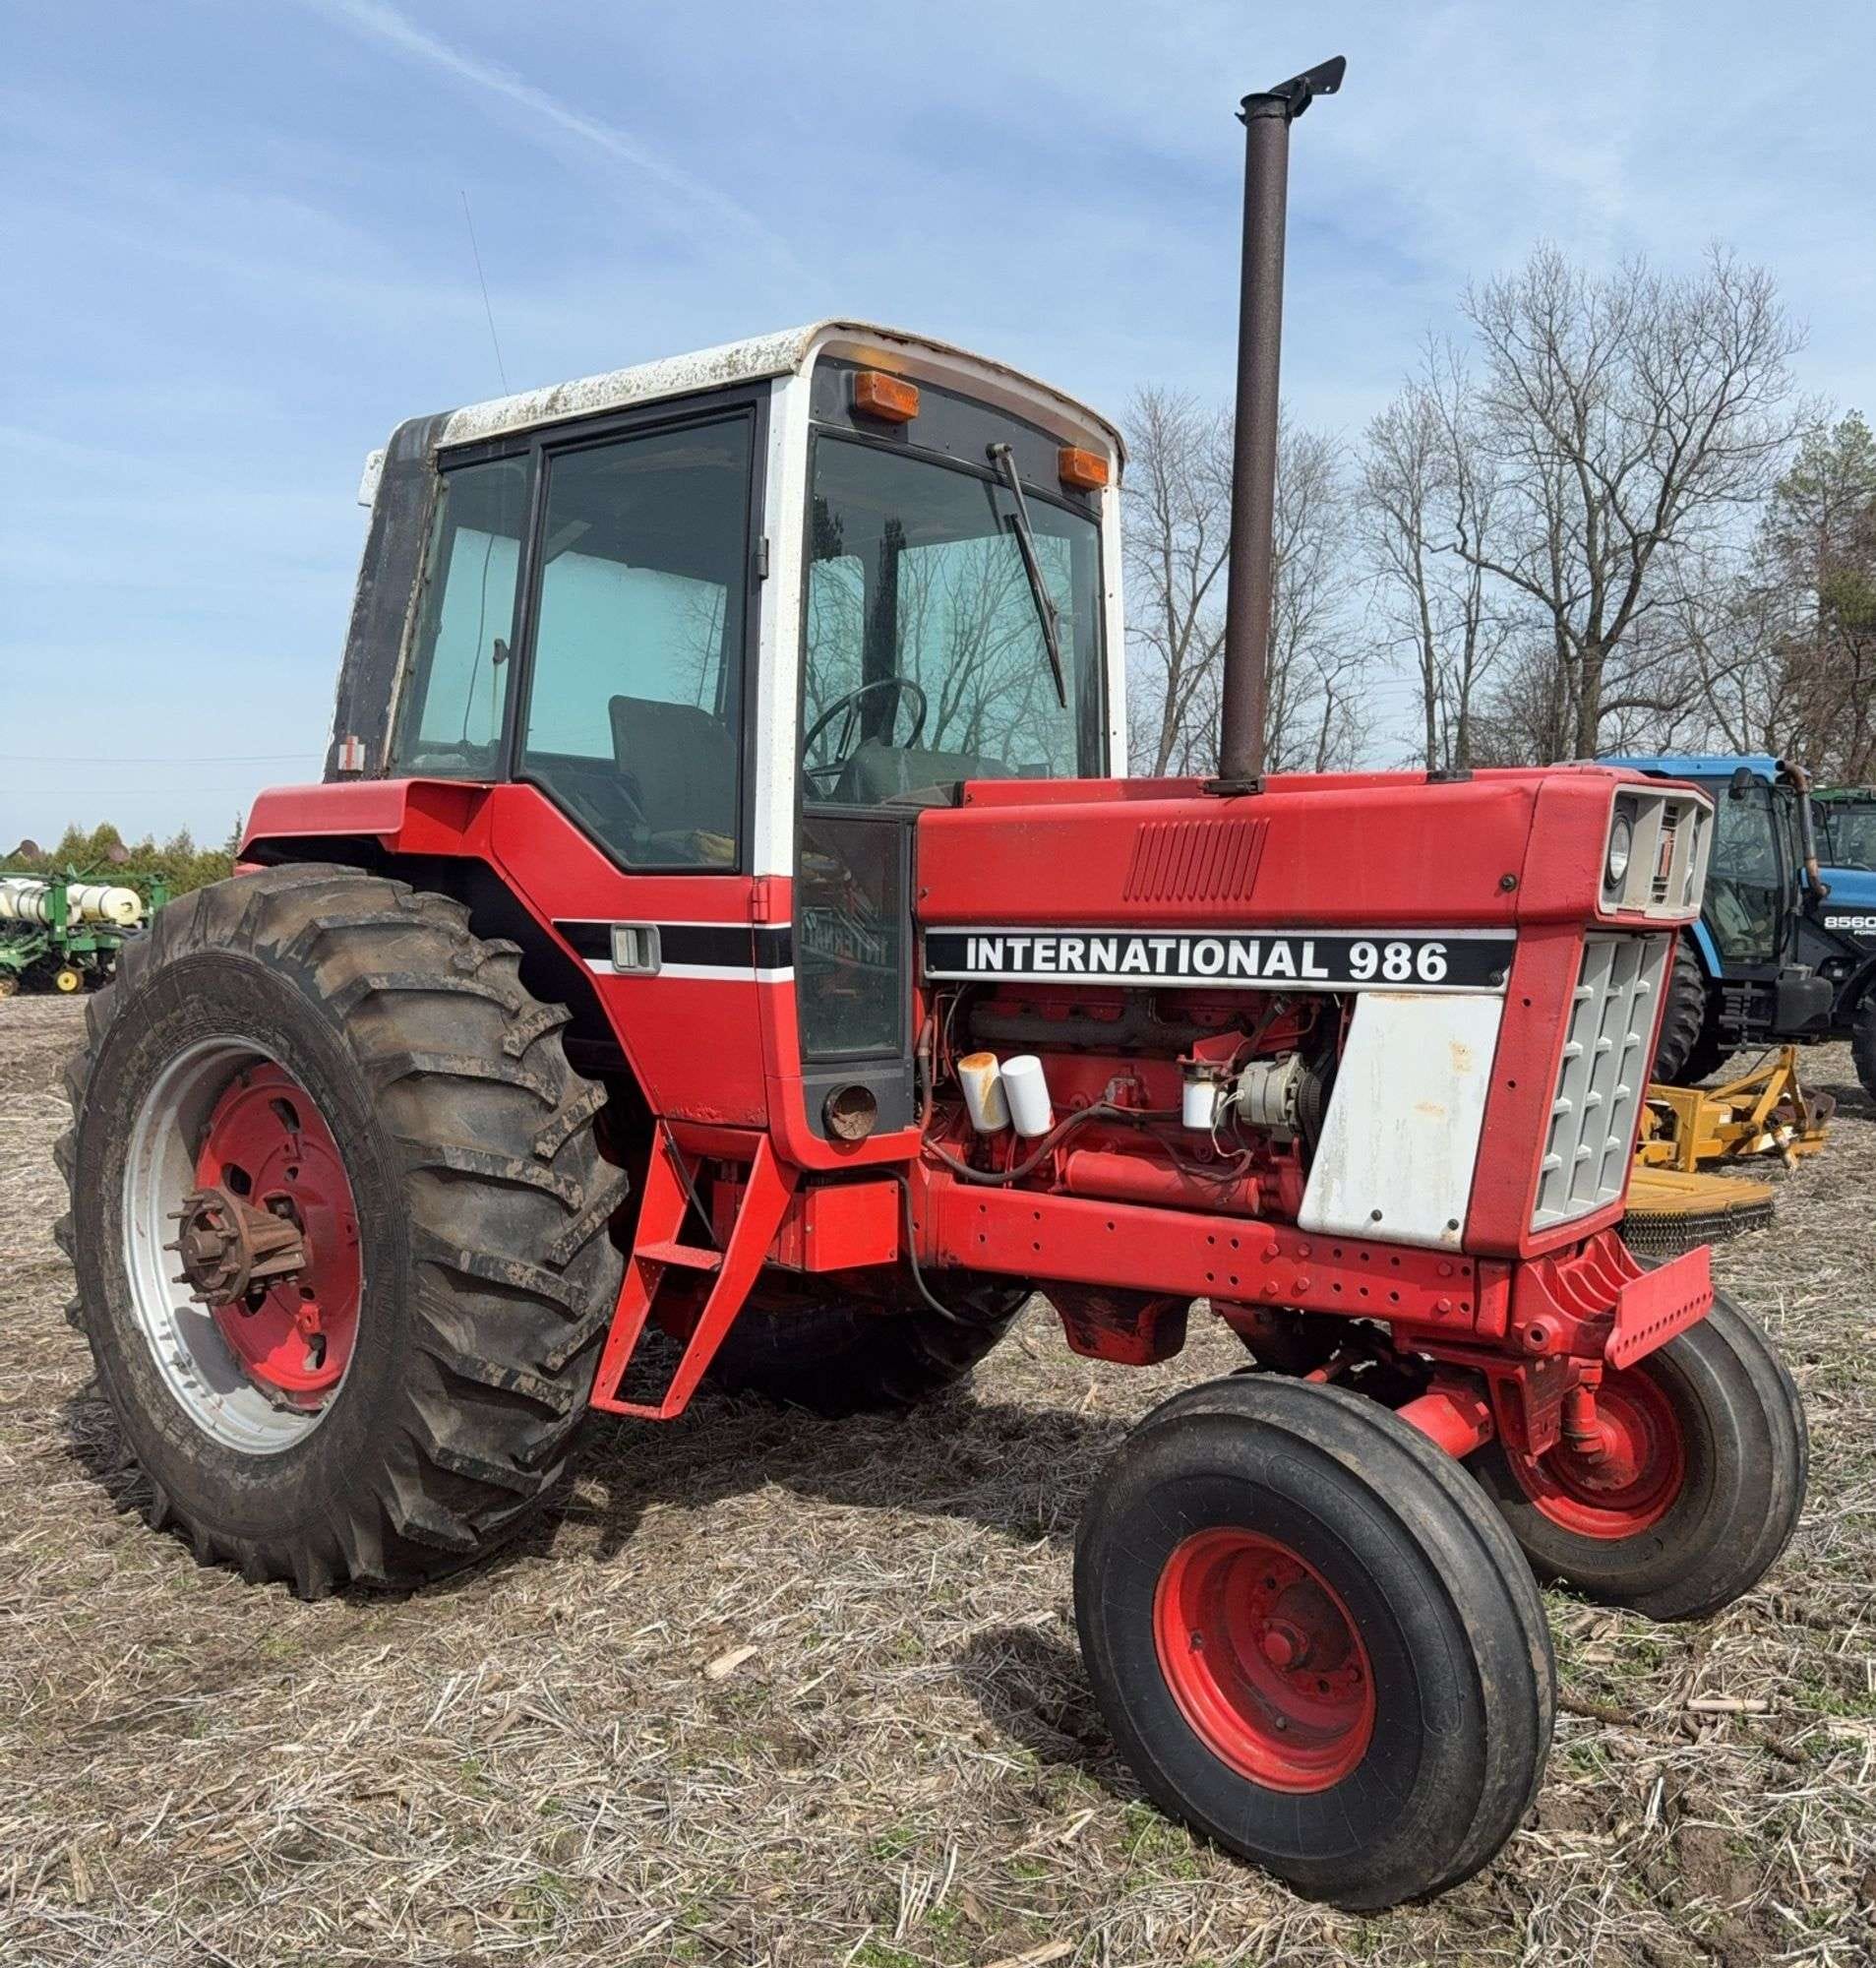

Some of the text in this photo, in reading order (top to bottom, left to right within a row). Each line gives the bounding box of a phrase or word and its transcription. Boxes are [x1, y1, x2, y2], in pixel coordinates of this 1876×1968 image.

[1824, 916, 1876, 928] 8560
[966, 938, 1448, 982] INTERNATIONAL 986
